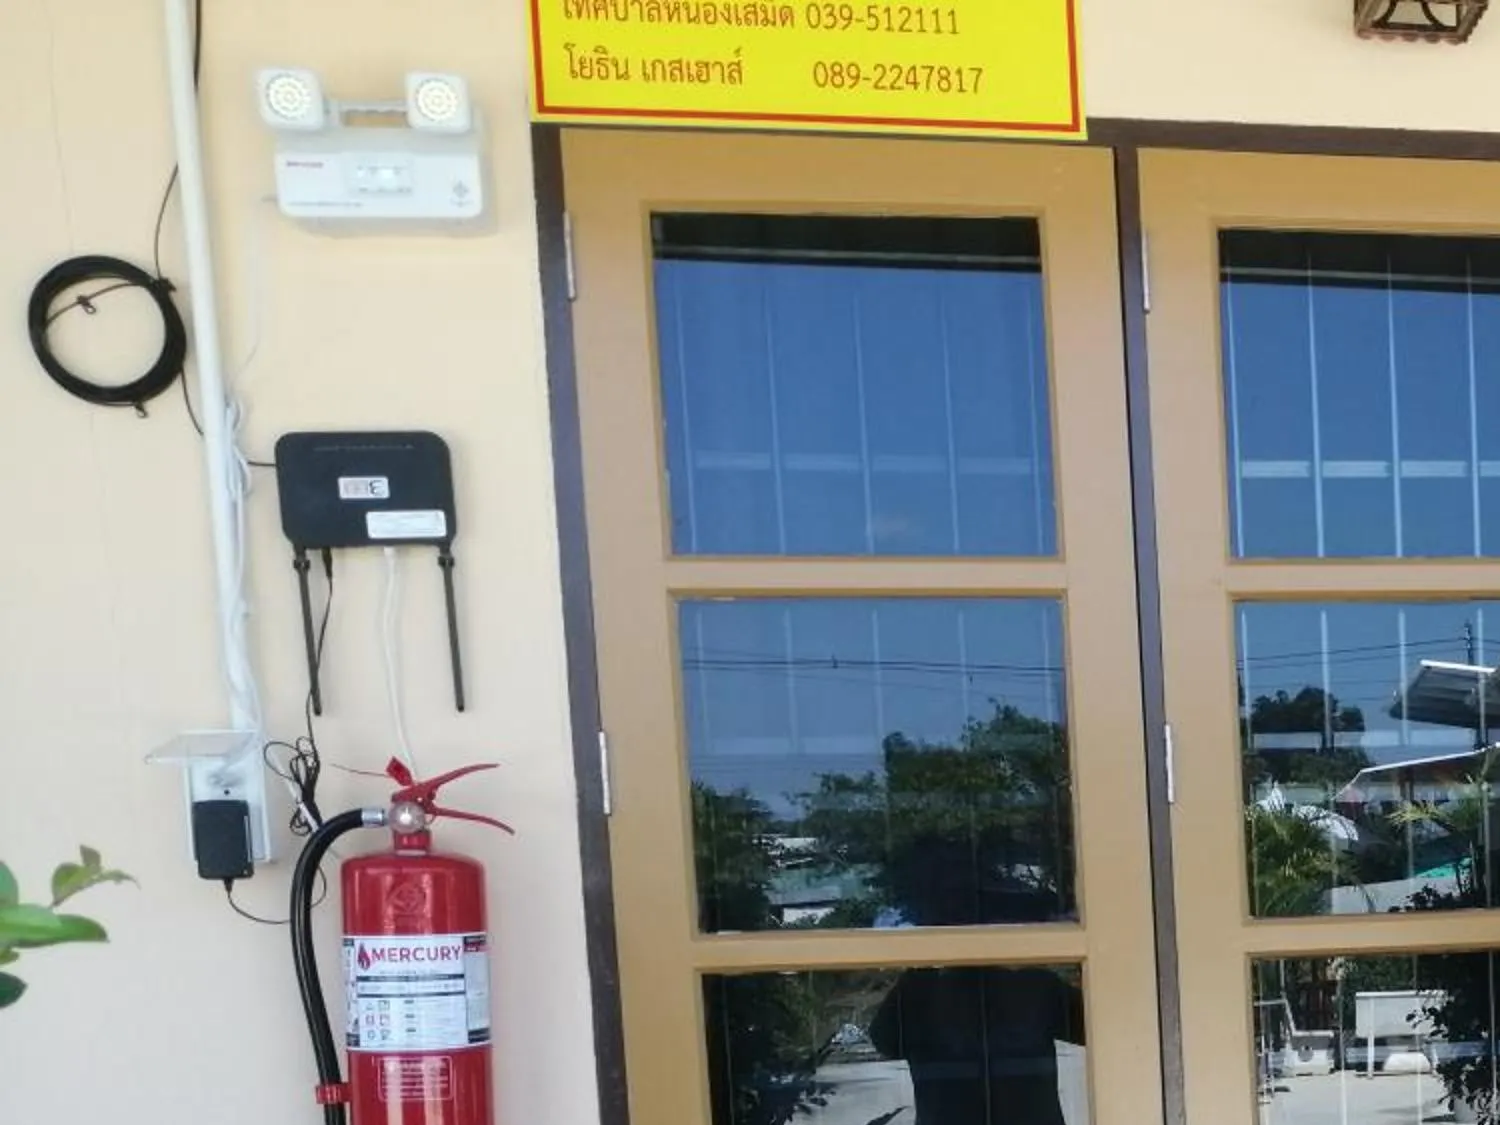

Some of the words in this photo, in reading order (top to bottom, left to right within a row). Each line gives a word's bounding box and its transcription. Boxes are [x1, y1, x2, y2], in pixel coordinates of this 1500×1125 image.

[805, 2, 961, 35] 039-512111
[563, 42, 631, 81] โยธิน
[641, 47, 743, 84] เกสเฮาส์
[813, 60, 984, 94] 089-2247817
[371, 945, 462, 963] MERCURY
